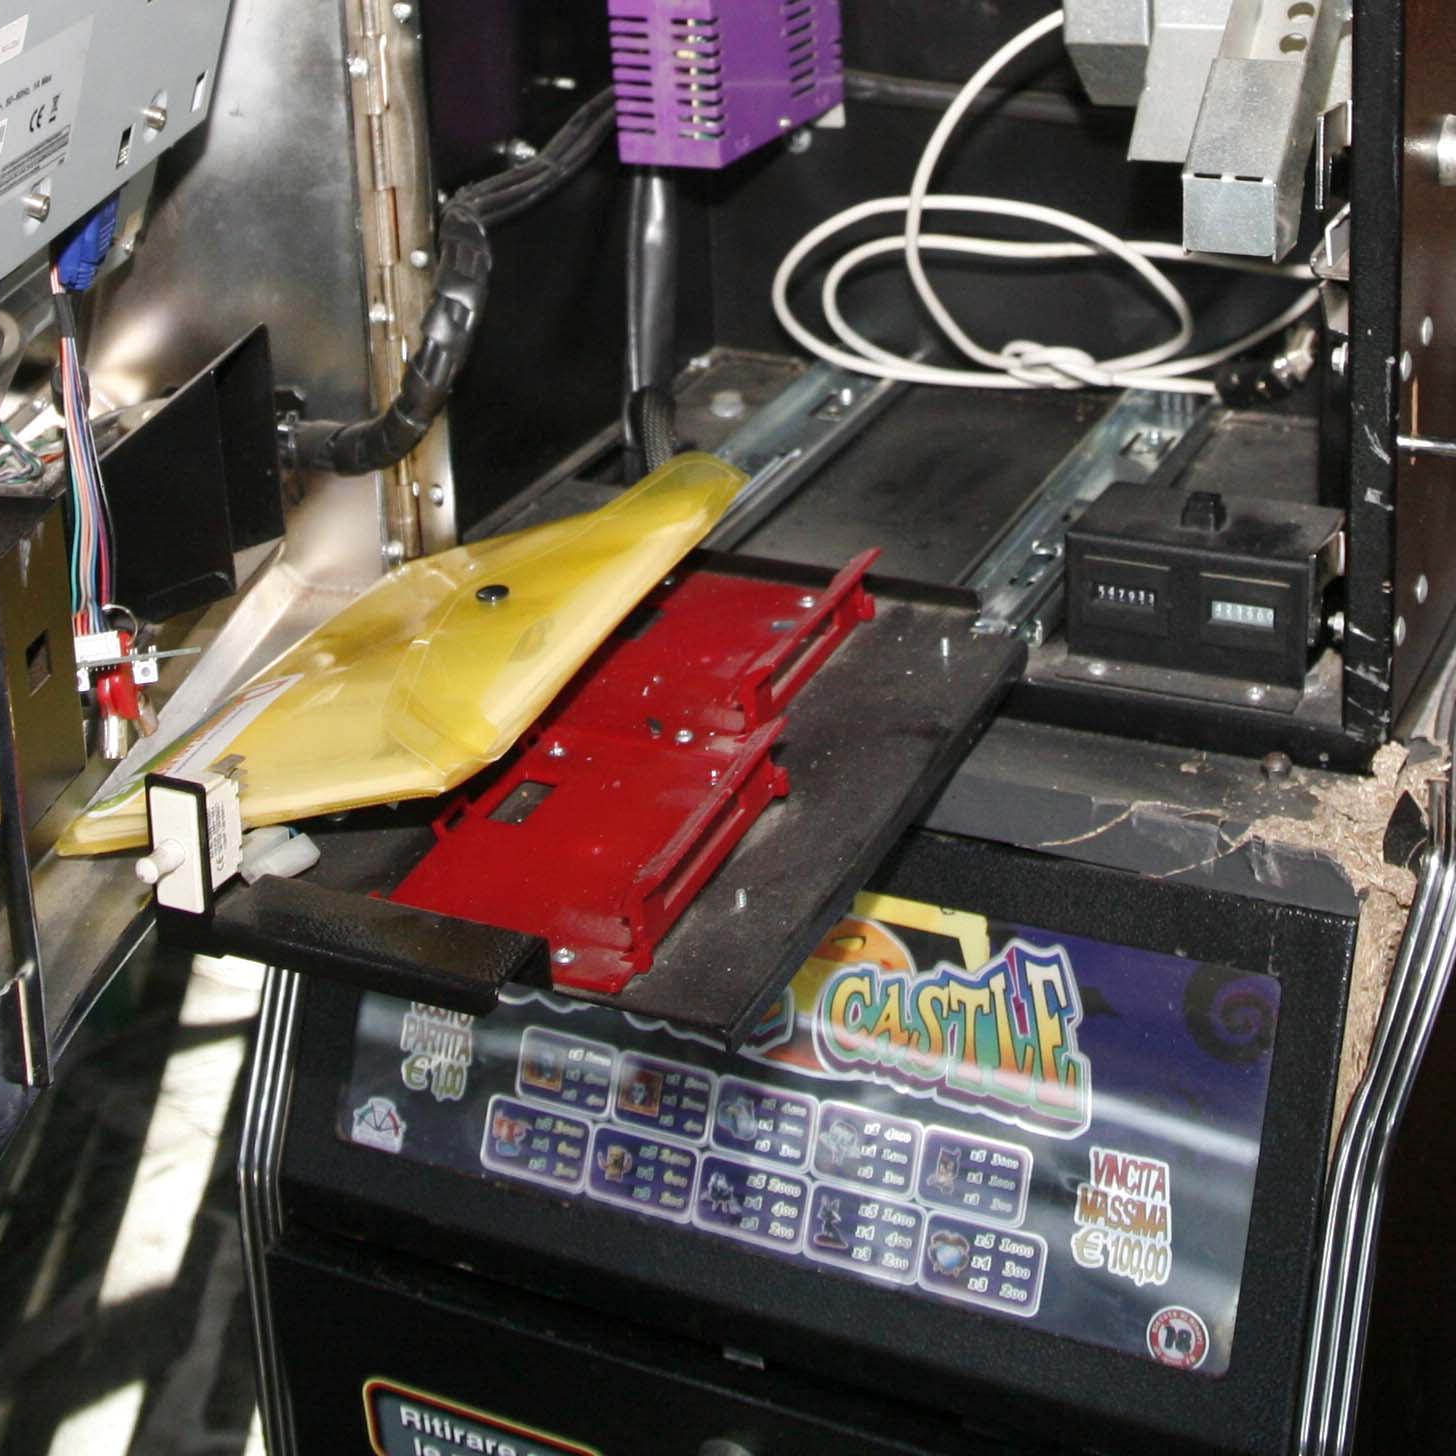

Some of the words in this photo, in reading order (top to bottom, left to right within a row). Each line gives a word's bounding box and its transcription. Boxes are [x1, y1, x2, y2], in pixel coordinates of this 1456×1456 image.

[824, 955, 1082, 1115] CASTLE
[1092, 1150, 1168, 1201] VINCITA
[1077, 1186, 1169, 1242] MASSIMA
[1074, 1227, 1106, 1268] €
[1107, 1235, 1171, 1285] 100,00
[399, 1404, 517, 1456] Ritirare
